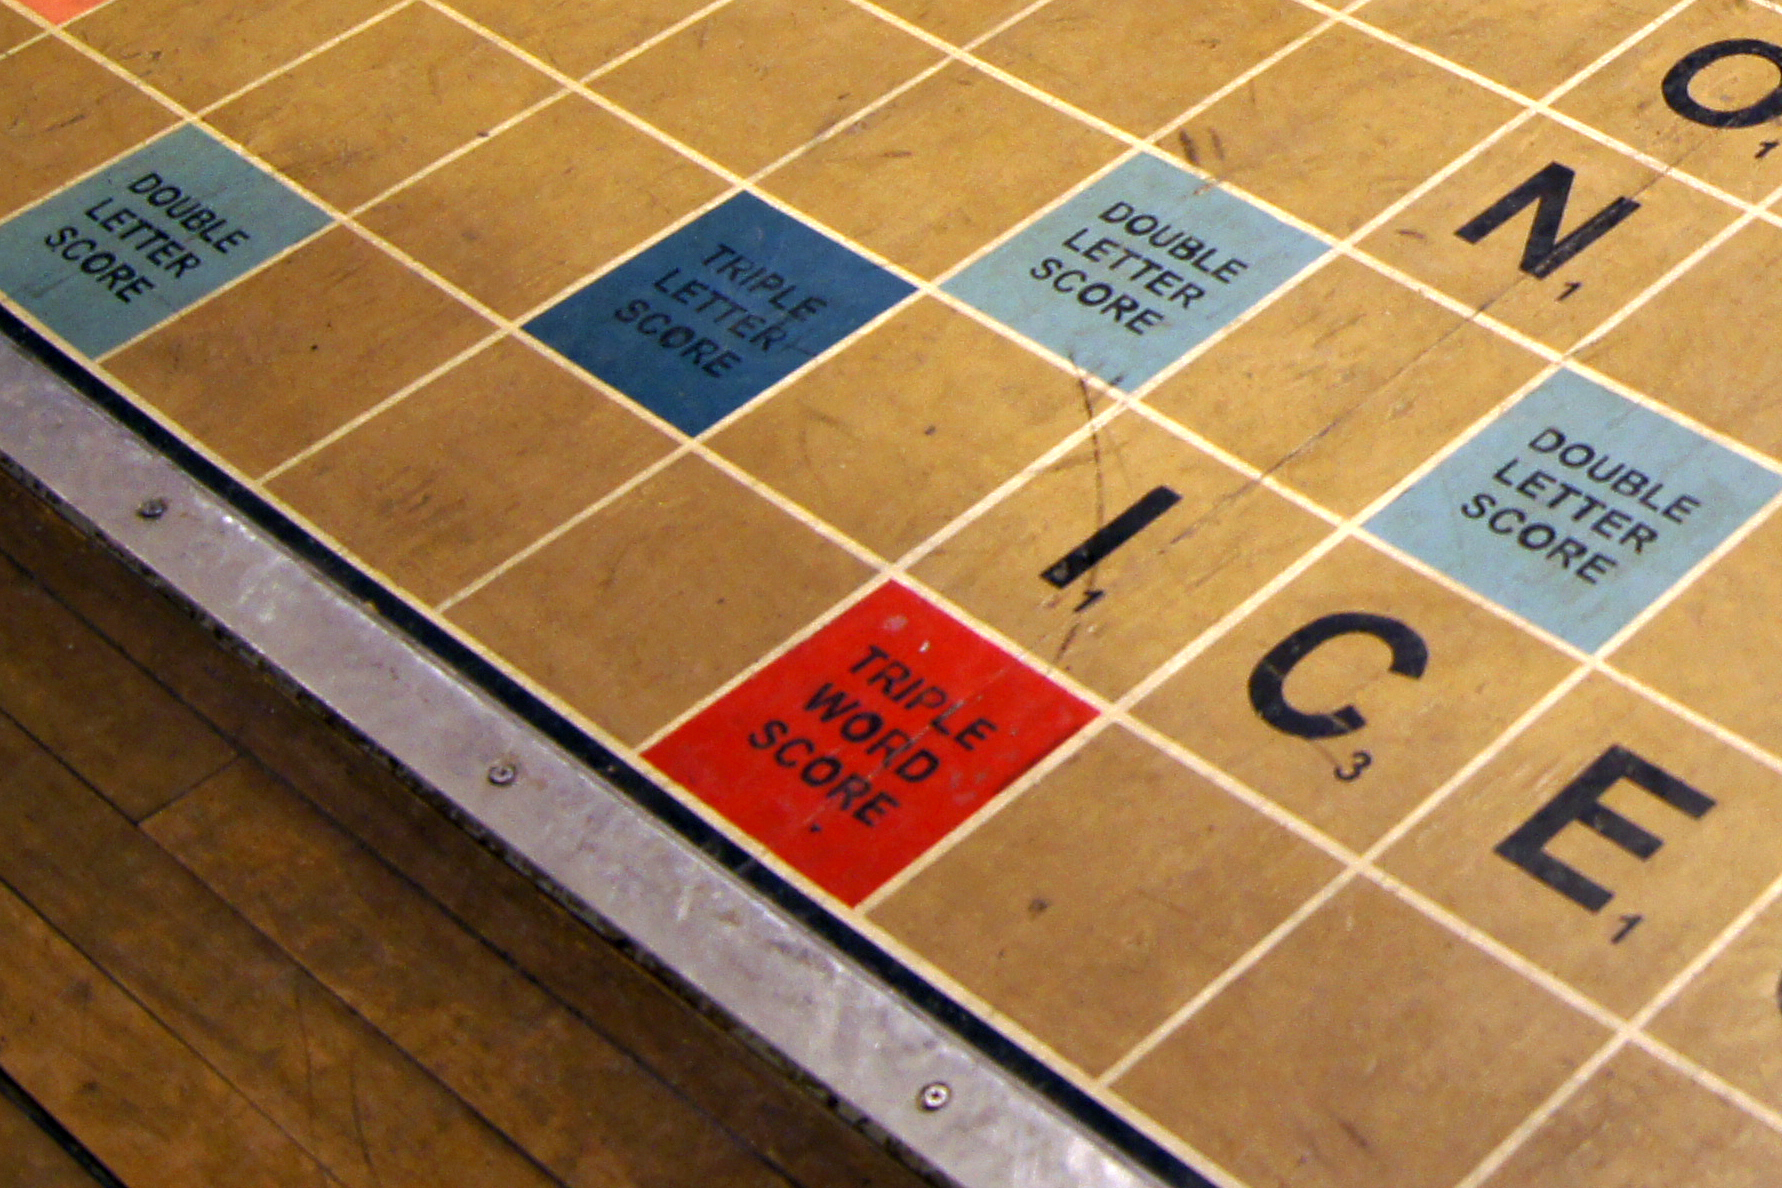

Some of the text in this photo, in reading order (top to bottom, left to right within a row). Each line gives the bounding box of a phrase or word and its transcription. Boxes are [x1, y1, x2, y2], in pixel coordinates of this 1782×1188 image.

[84, 197, 202, 279] LETTER
[126, 171, 251, 255] DOUBLE
[1098, 201, 1250, 285] DOUBLE
[43, 225, 156, 304] SCORE
[701, 242, 832, 323] TRIPLE
[1029, 257, 1165, 336] SCORE
[1062, 227, 1207, 310] LETTER
[612, 298, 744, 380] SCORE
[651, 266, 788, 353] LETTER
[1491, 458, 1660, 555] LETTER
[1528, 426, 1702, 524] DOUBLE
[1460, 492, 1618, 585] SCORE
[803, 681, 942, 784] WORD
[849, 644, 999, 752] TRIPLE
[747, 718, 901, 827] SCORE
